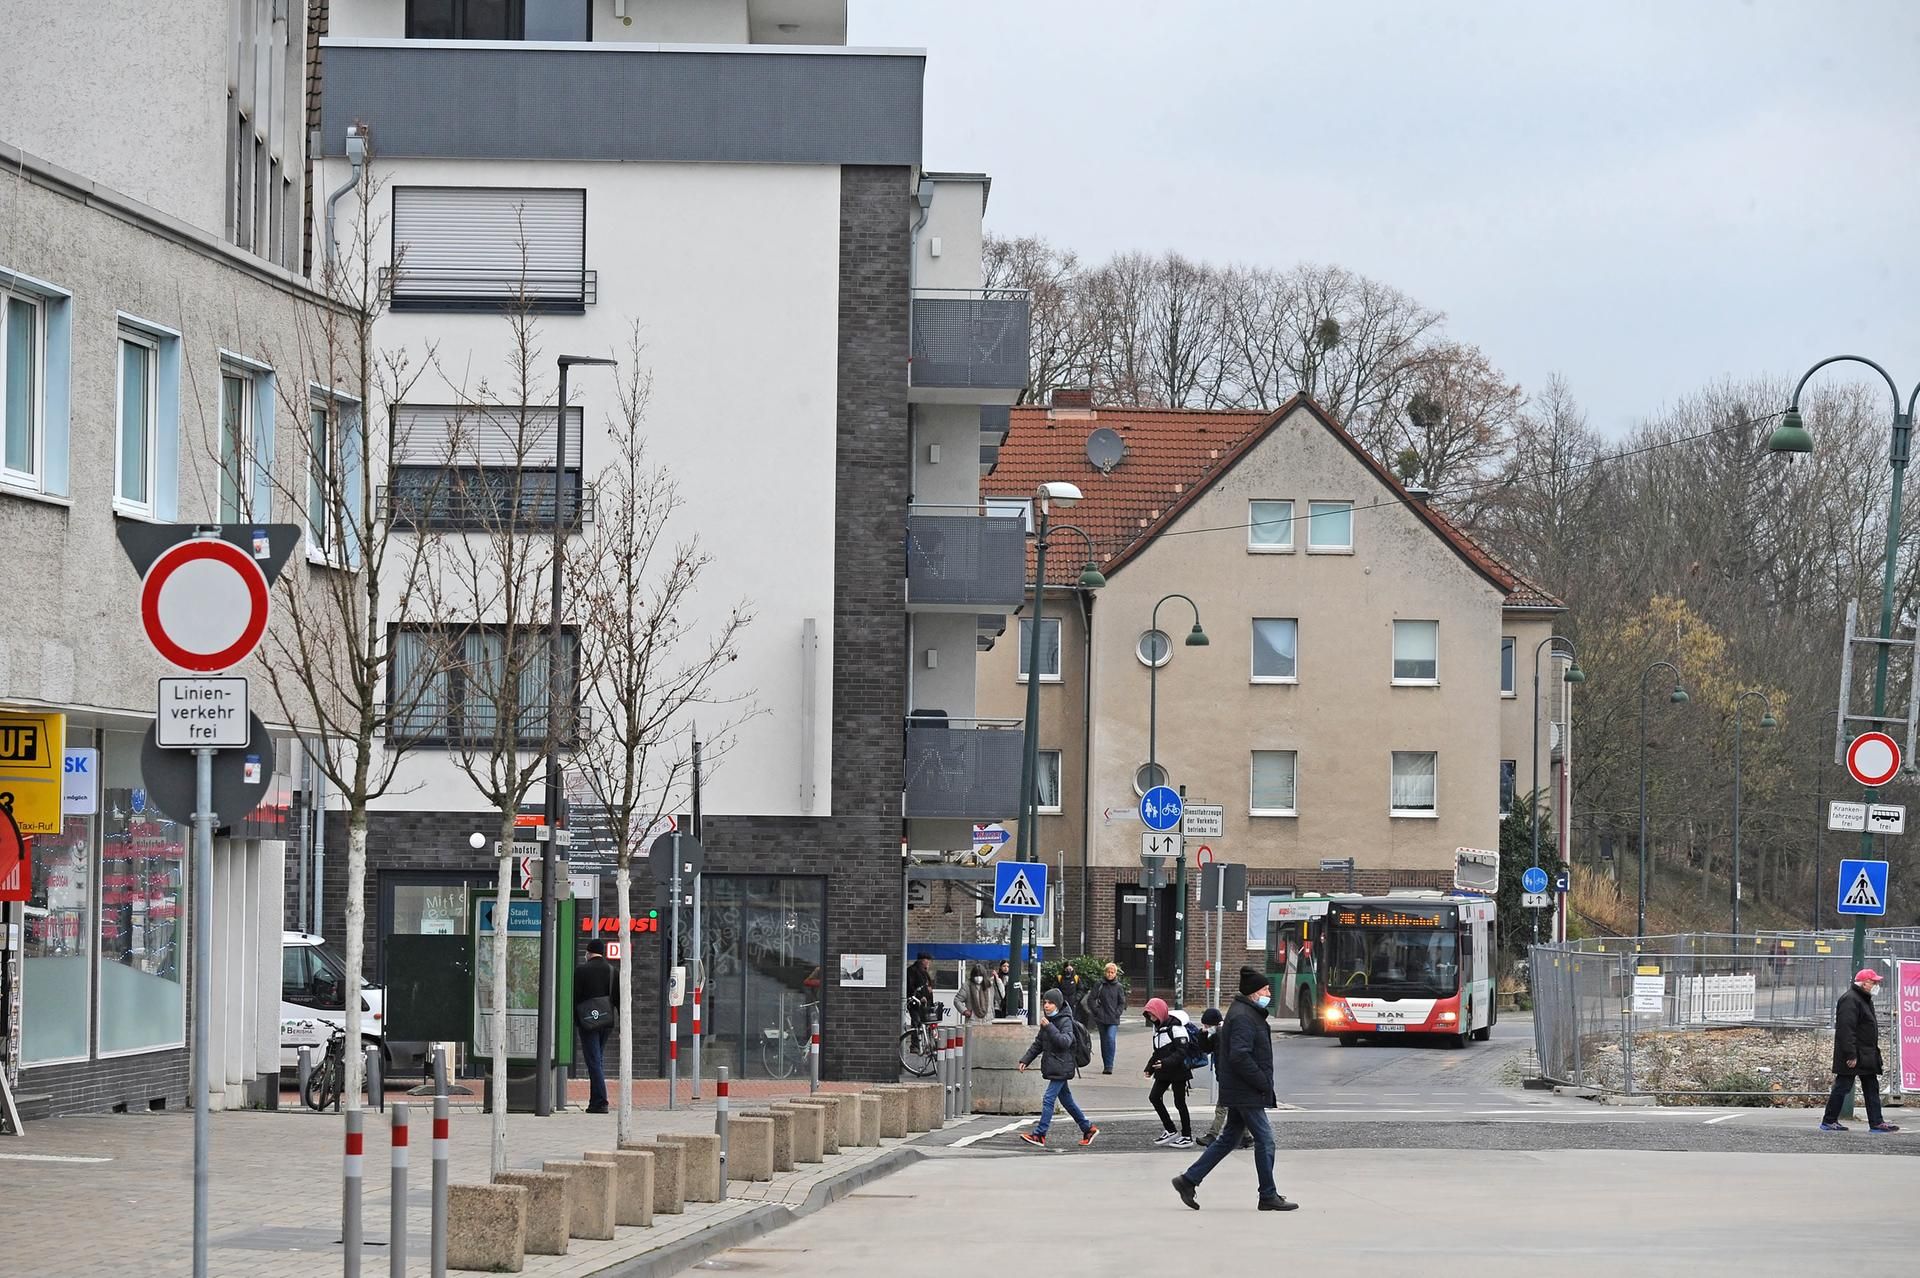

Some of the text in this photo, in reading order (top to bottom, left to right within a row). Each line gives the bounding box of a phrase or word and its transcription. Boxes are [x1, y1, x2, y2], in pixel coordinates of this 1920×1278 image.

[174, 685, 231, 701] Linien-
[171, 706, 235, 720] verkehr
[190, 723, 217, 739] frei
[1833, 805, 1863, 813] Kranken-
[1832, 813, 1863, 821] fahrzeuge
[19, 821, 54, 831] Taxi-Ruf
[510, 908, 529, 917] Stadt
[1351, 1000, 1375, 1009] wupsi
